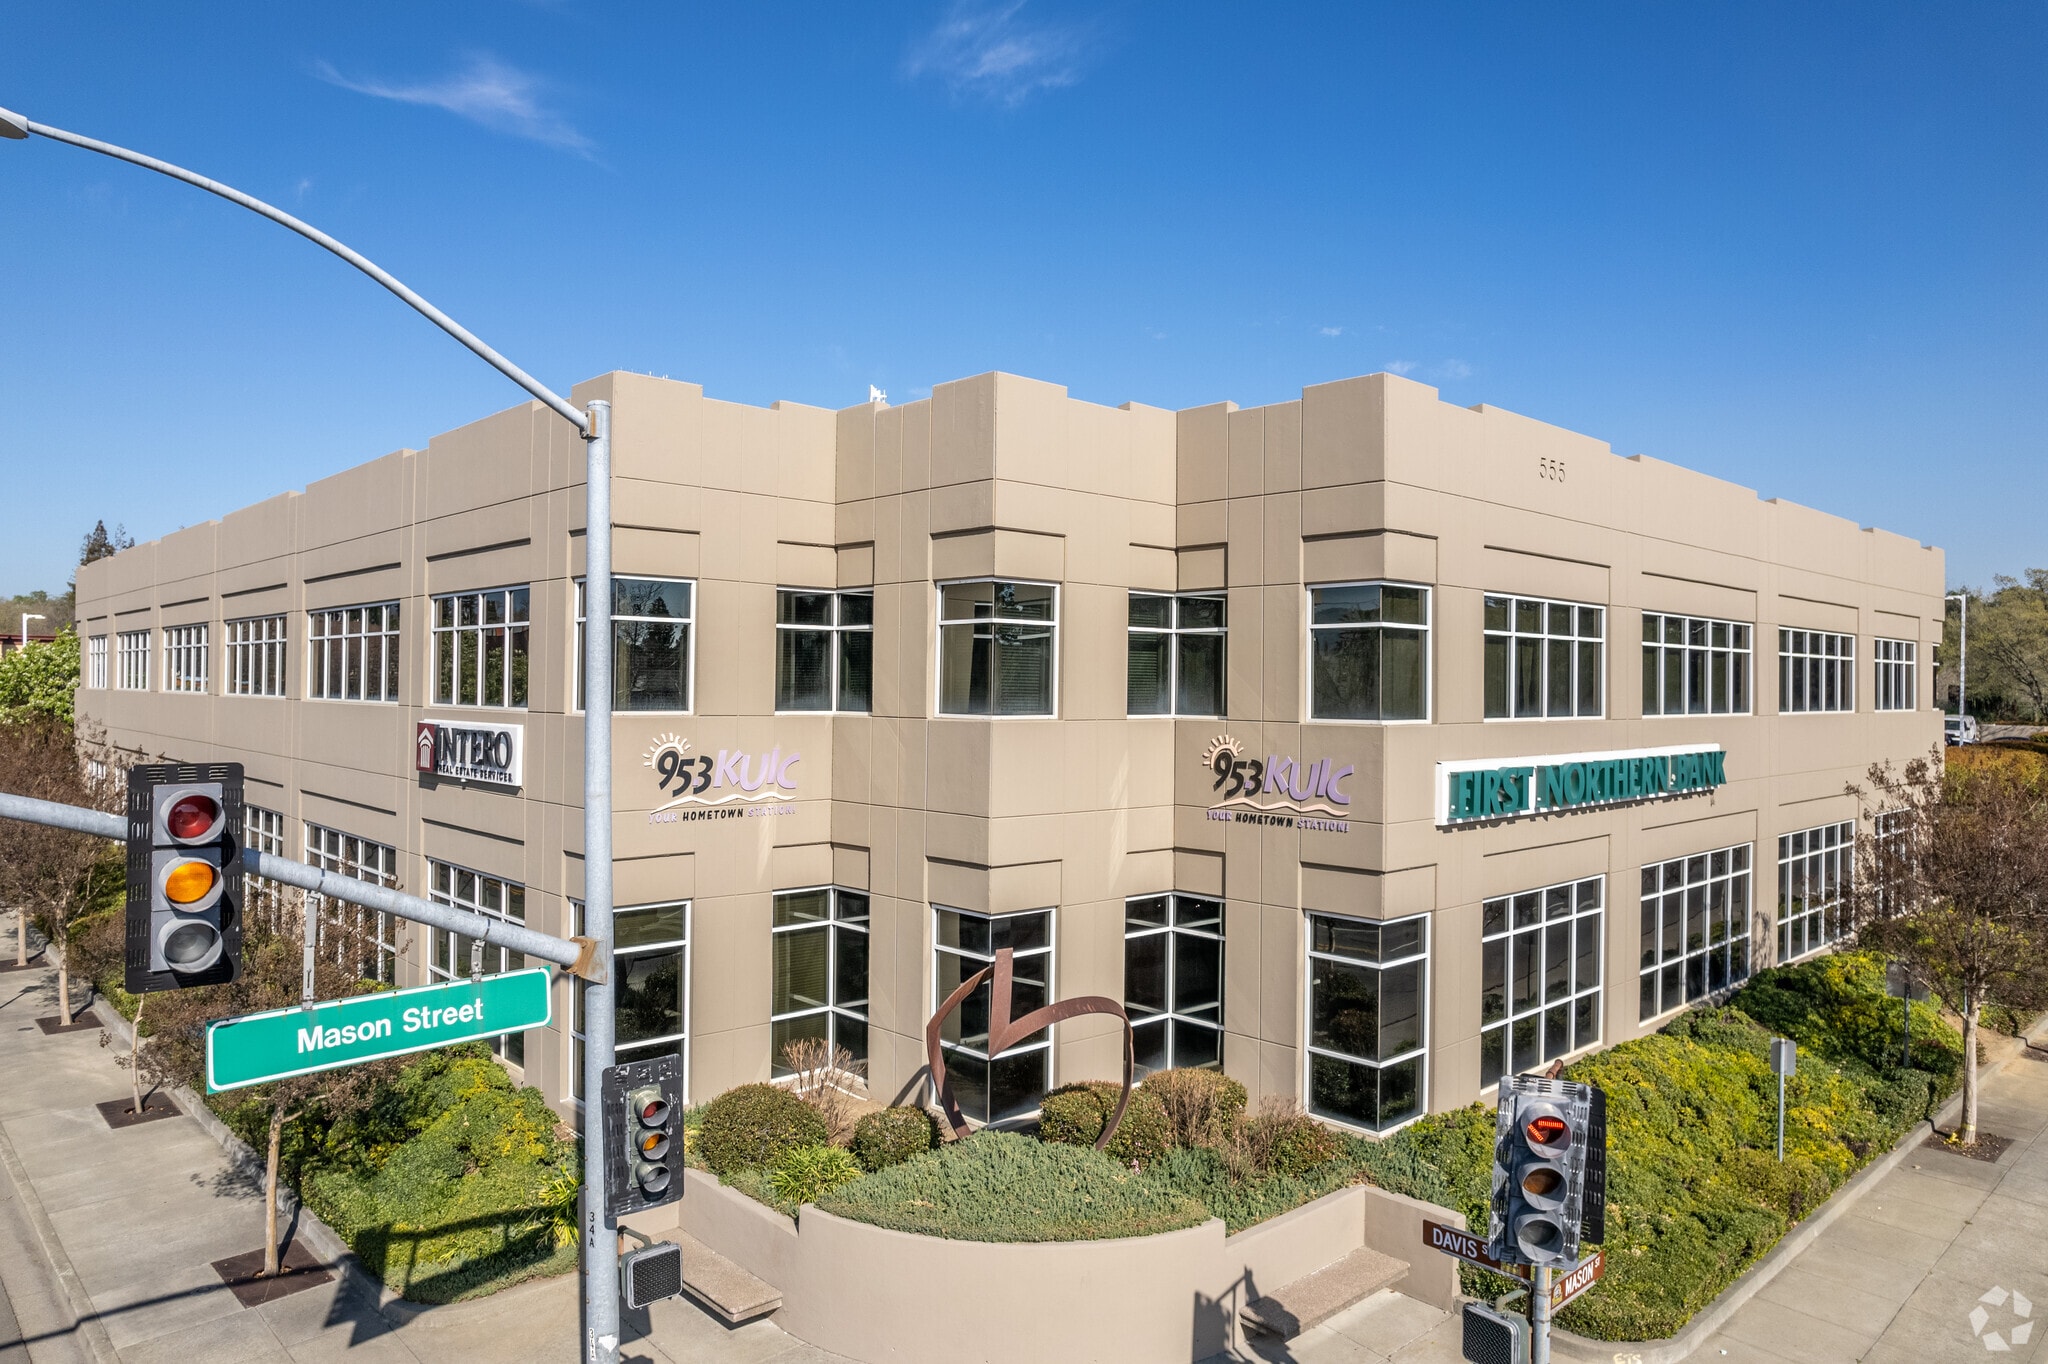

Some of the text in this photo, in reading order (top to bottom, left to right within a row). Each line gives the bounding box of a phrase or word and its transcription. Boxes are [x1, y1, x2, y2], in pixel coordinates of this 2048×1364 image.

[1540, 457, 1566, 483] 555
[438, 764, 453, 775] REAL
[455, 765, 478, 779] ESTATE
[1449, 751, 1727, 819] FIRST NORTHERN BANK
[648, 812, 678, 825] YOUR
[682, 808, 744, 822] HOMETOWN
[1206, 810, 1350, 834] YOUR HOMETOWN STATION!
[297, 998, 484, 1053] Mason Street
[1432, 1227, 1478, 1258] DAVIS
[1565, 1261, 1594, 1297] MASON
